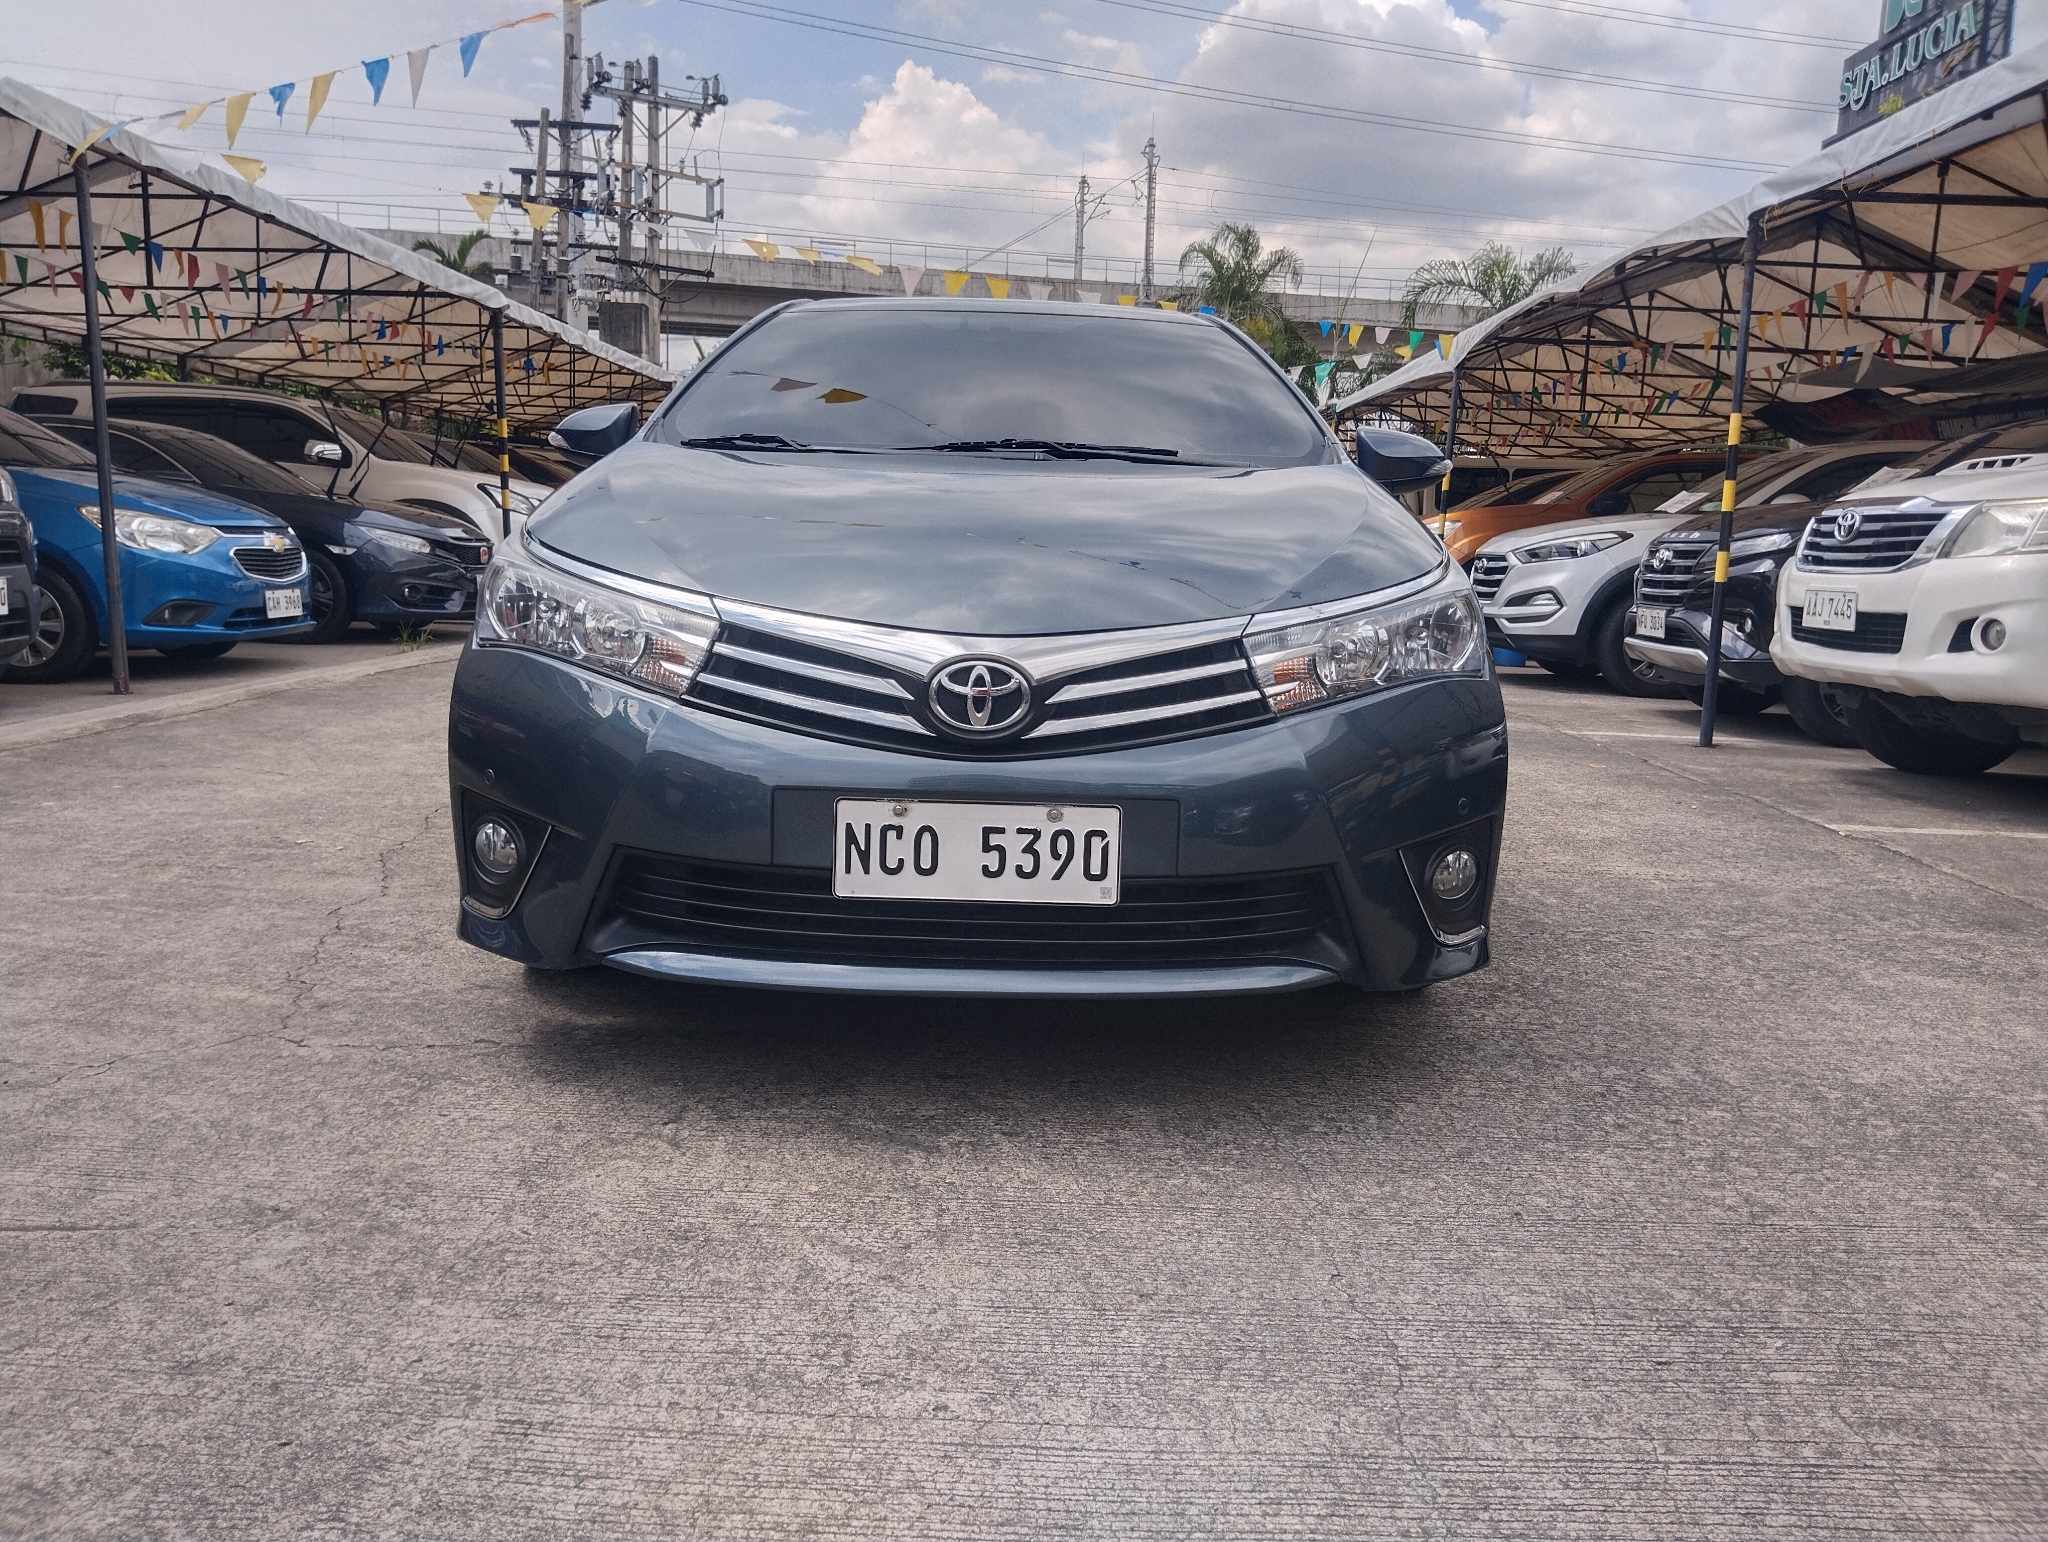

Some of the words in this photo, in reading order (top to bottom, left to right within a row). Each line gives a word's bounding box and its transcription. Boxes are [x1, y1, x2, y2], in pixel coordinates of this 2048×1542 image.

[1828, 597, 1853, 618] 7445
[844, 822, 939, 877] NCO
[981, 826, 1111, 882] 5390
